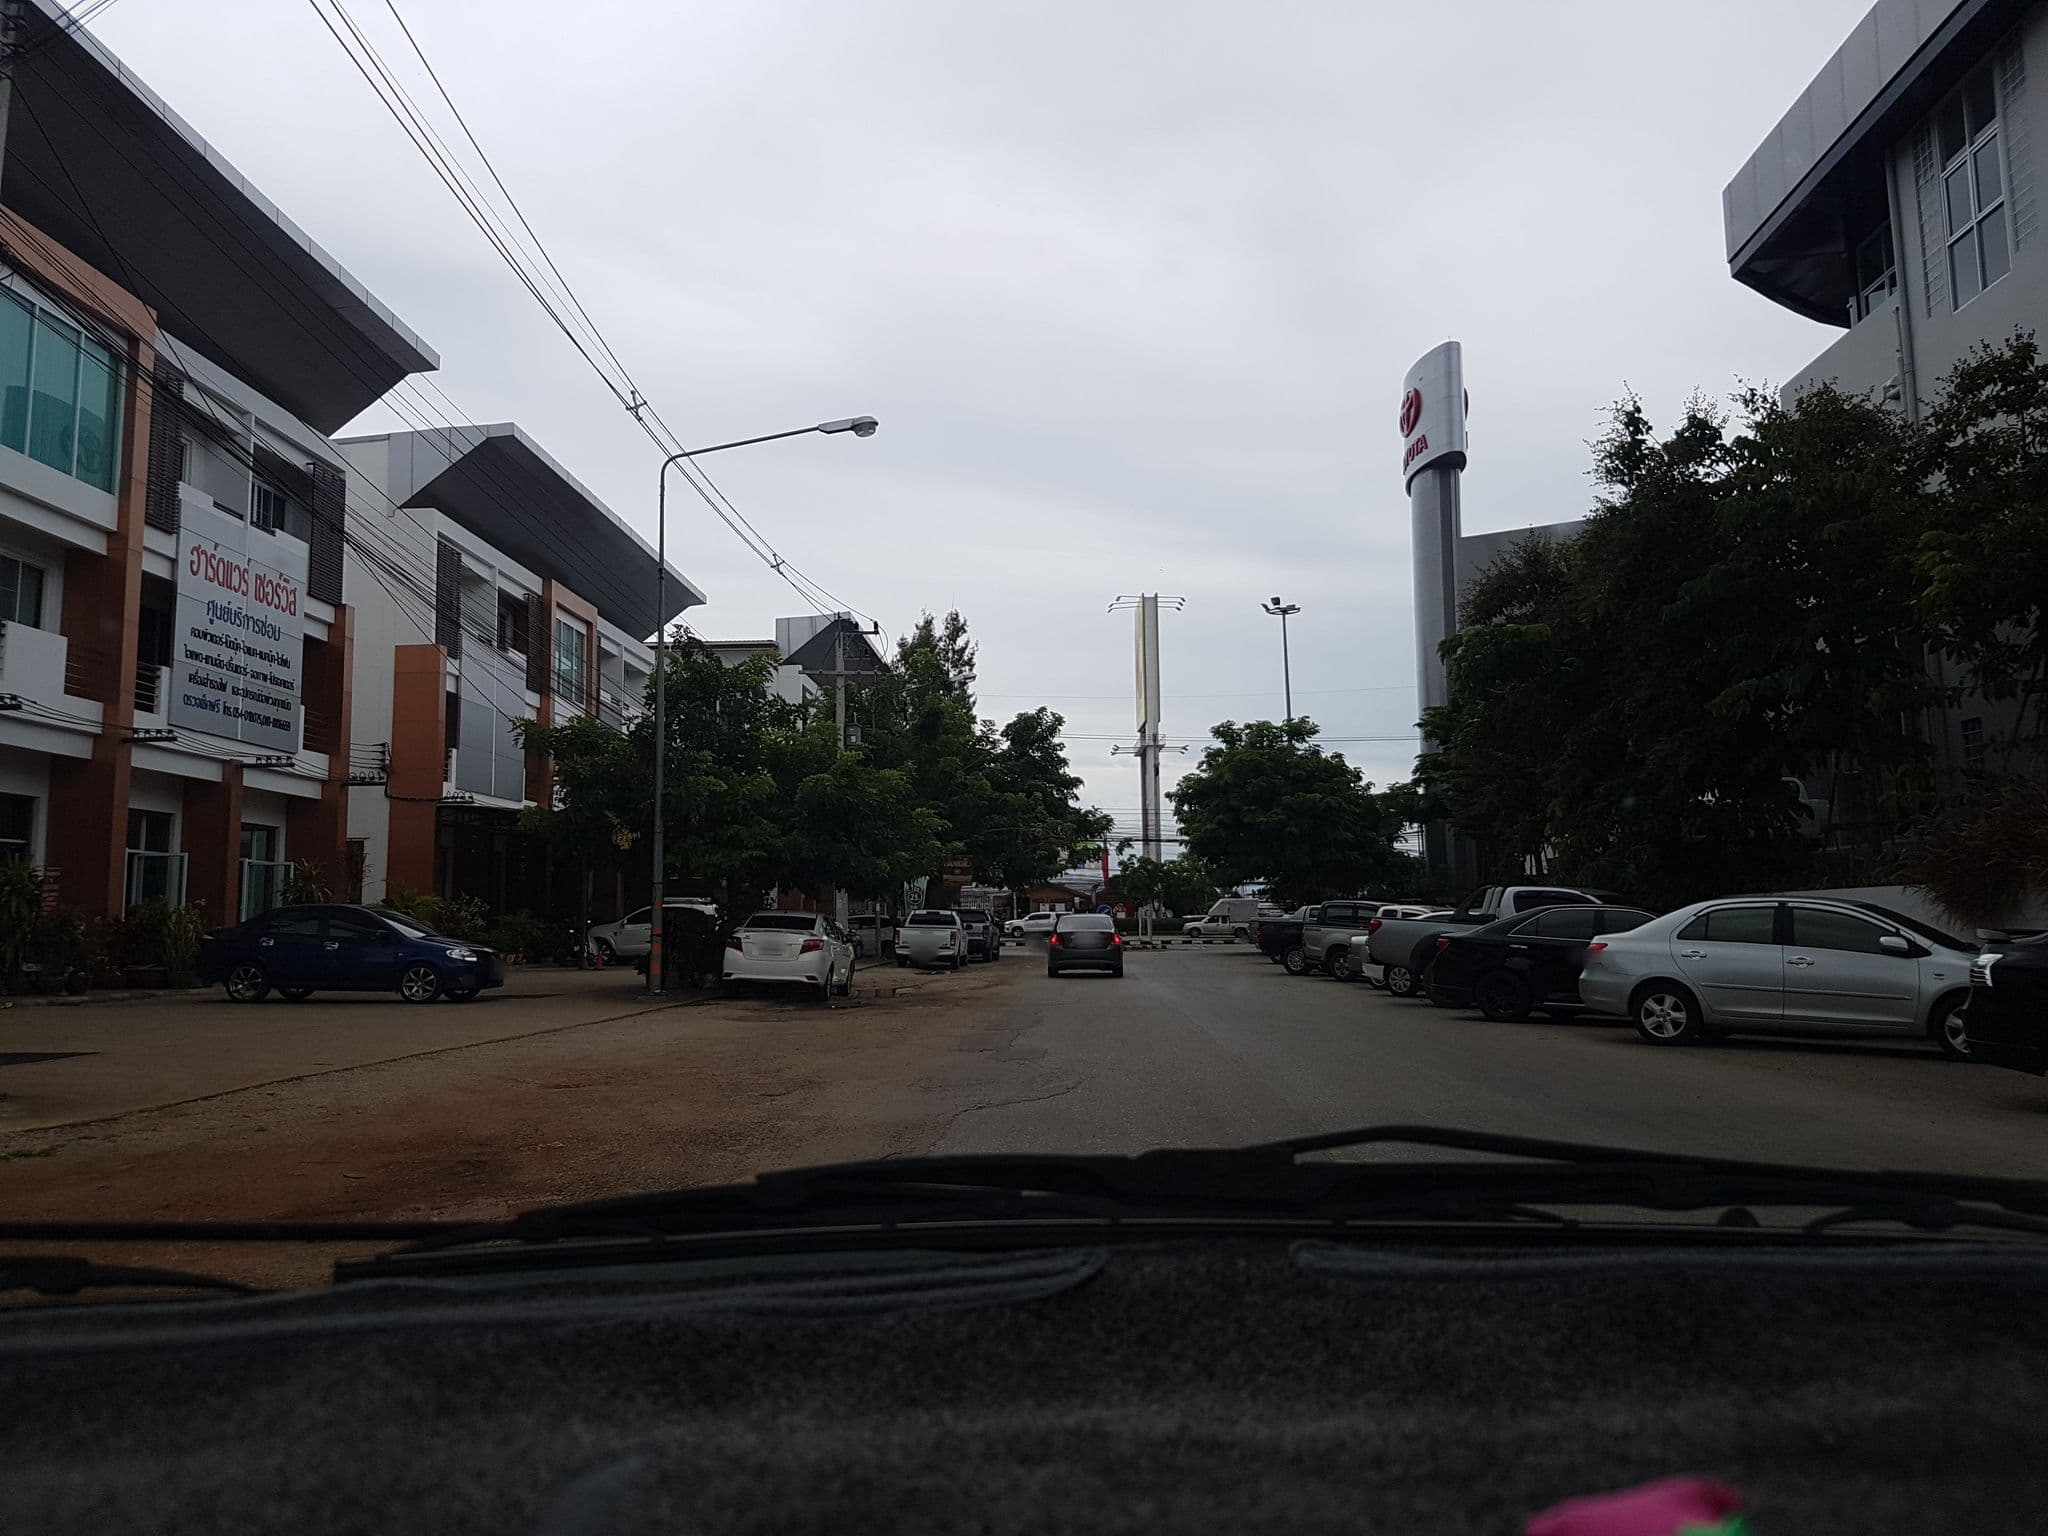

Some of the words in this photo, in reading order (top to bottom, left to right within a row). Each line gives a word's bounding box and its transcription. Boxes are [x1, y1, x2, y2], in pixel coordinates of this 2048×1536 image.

[189, 542, 251, 597] ฮาร์ดแวร์
[255, 572, 297, 616] เซอร์วิส
[206, 599, 281, 642] ศูนย์บริการซ่อม
